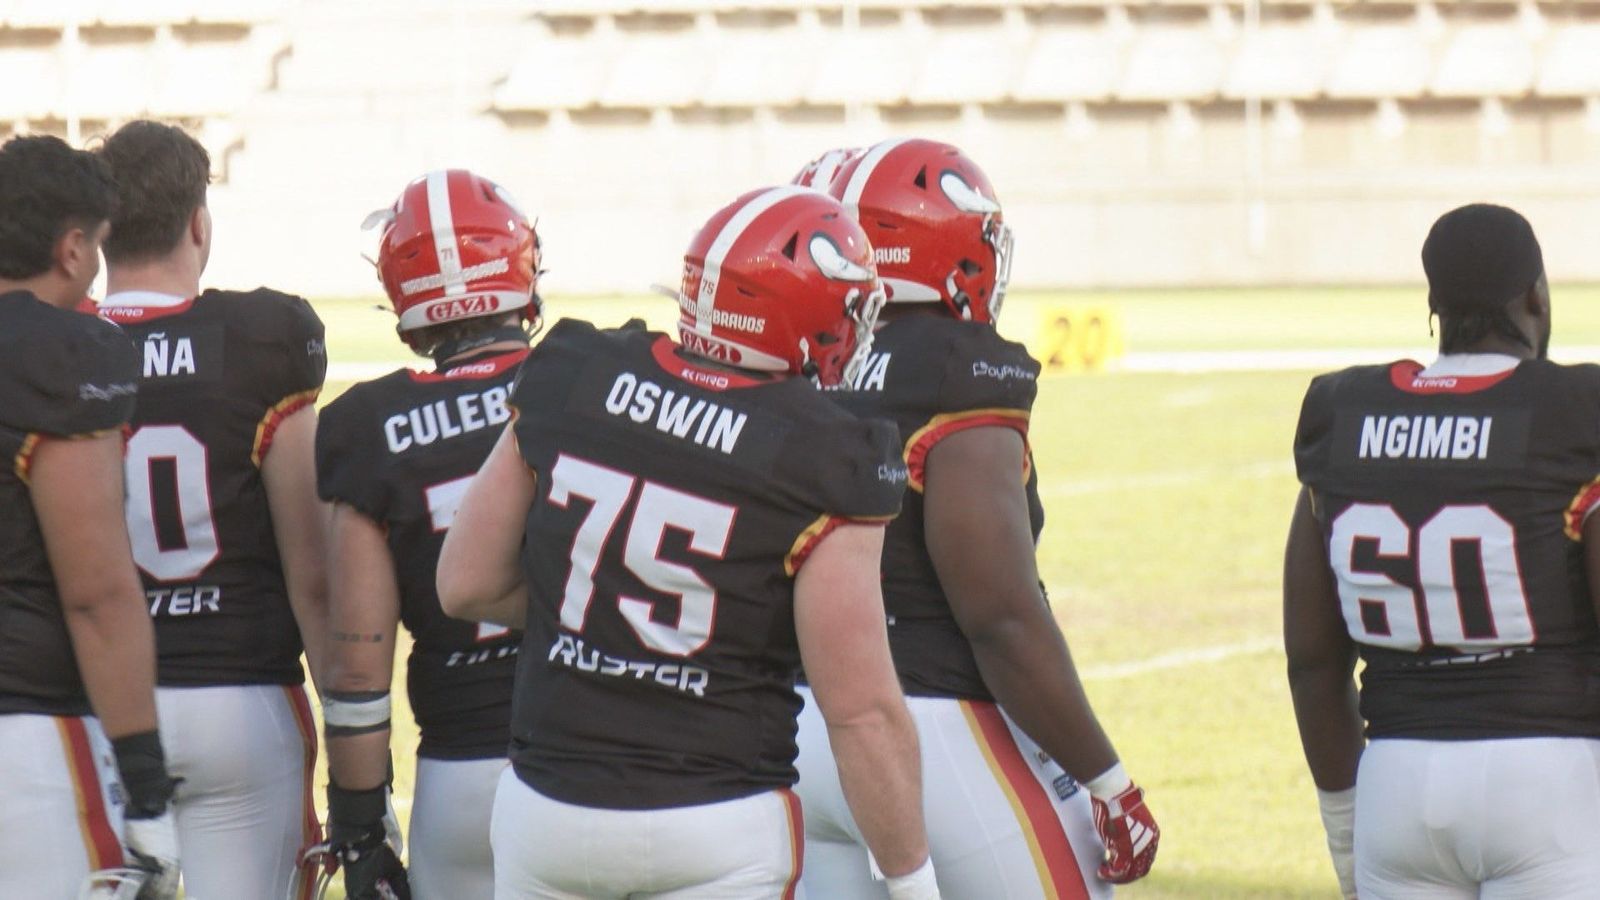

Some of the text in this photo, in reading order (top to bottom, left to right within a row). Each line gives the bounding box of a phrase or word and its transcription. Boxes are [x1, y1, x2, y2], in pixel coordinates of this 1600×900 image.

[872, 246, 911, 264] AVOS
[431, 295, 495, 320] GAZI
[702, 280, 715, 296] 75
[384, 380, 515, 455] CULEB
[605, 371, 749, 455] OSWIN
[1358, 415, 1493, 460] NGIMBI
[547, 452, 739, 658] 75
[1329, 501, 1537, 653] 60
